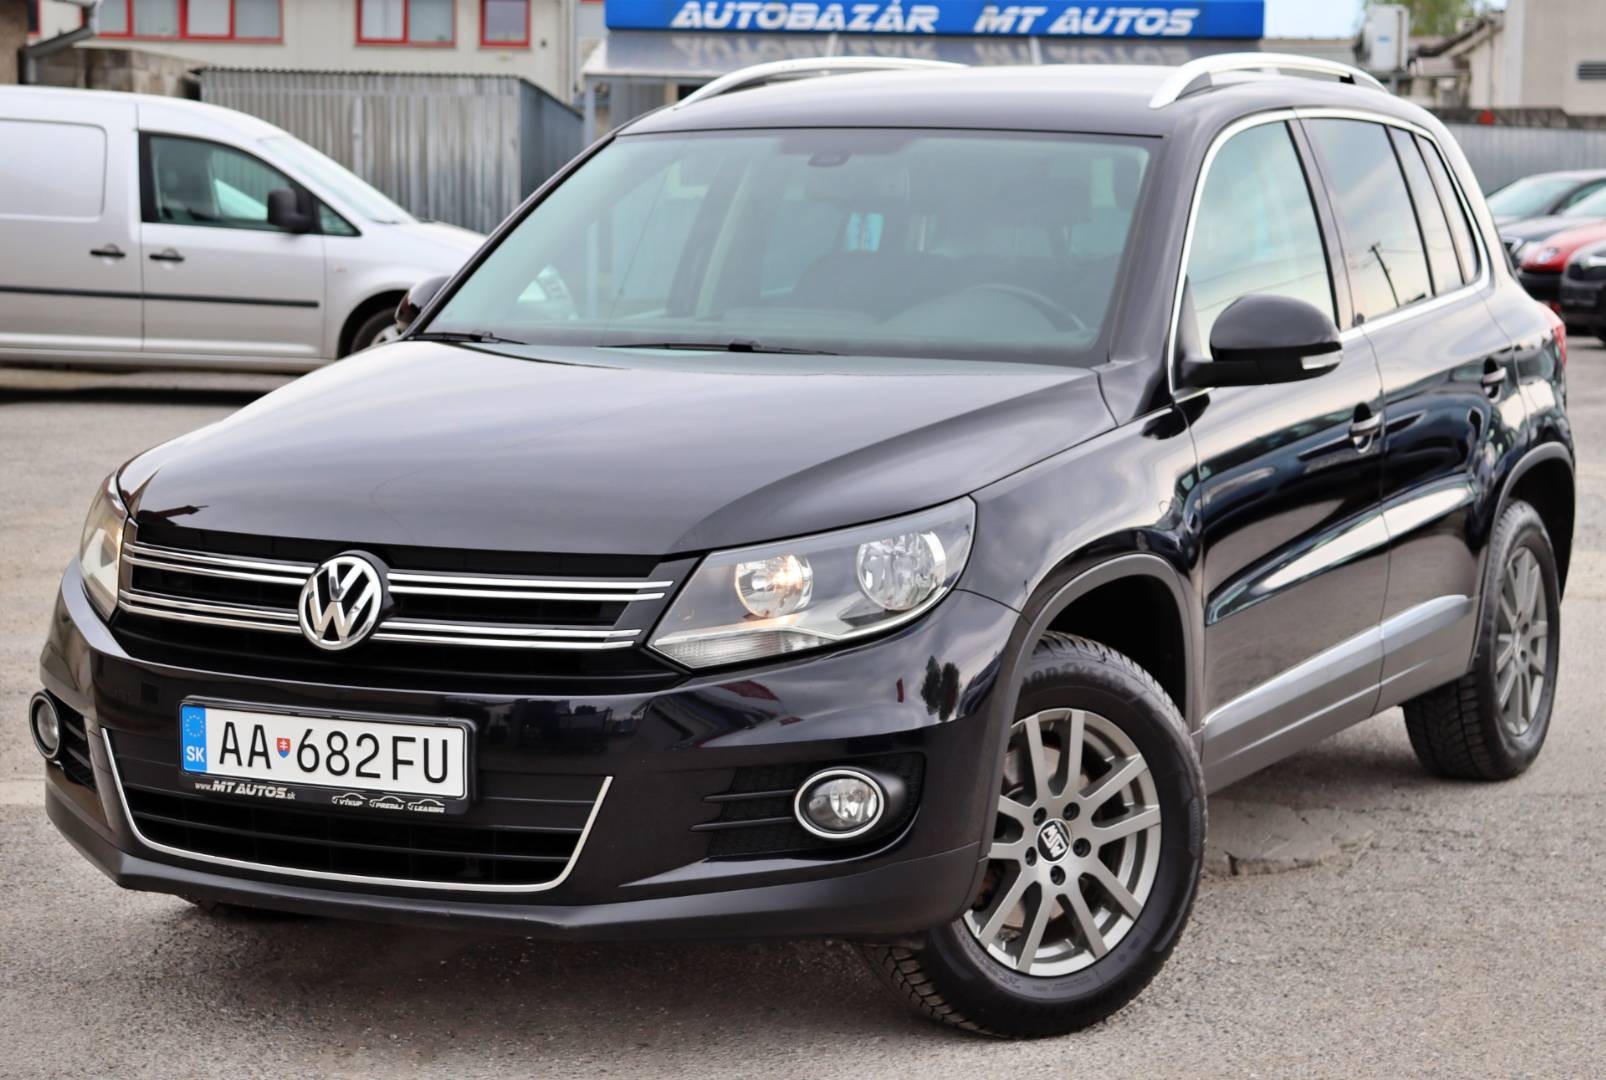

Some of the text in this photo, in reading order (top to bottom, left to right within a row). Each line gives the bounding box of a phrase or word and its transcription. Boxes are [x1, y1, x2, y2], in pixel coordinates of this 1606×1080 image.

[670, 0, 1201, 36] AUTOBAZÁR MT AUTOS
[186, 746, 205, 763] SK
[219, 721, 448, 784] AA 682FU
